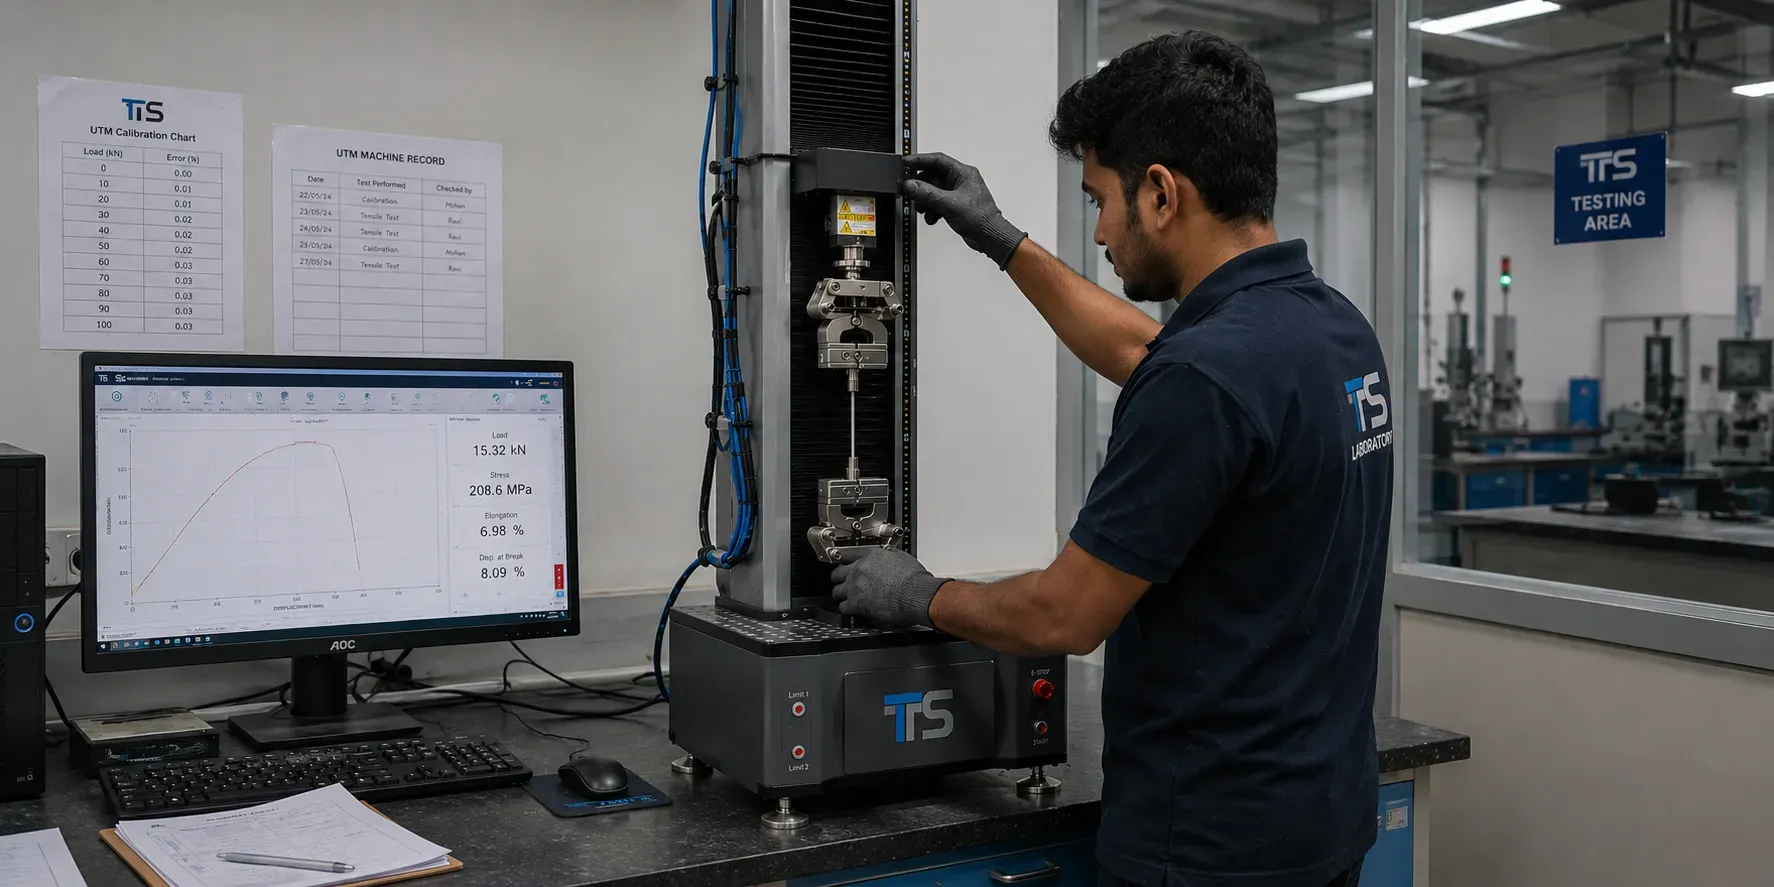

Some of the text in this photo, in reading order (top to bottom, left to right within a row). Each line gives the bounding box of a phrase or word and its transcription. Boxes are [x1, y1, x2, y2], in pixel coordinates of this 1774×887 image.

[90, 126, 196, 142] UTM Calibration Chart
[84, 148, 123, 158] Load (kN)
[167, 154, 186, 162] Error
[336, 149, 445, 166] UTM MACHINE RECORD
[101, 164, 106, 172] 0
[174, 170, 193, 178] 0.00
[99, 180, 109, 188] 10
[373, 180, 406, 189] Performed
[436, 185, 472, 195] Checked by
[98, 196, 109, 204] 20
[362, 196, 398, 204] Calibration
[1571, 190, 1646, 212] TESTING
[98, 211, 109, 219] 30
[360, 212, 382, 220] Tensile
[174, 216, 193, 224] 0.02
[1584, 212, 1632, 231] AREA
[174, 231, 193, 239] 0.02
[98, 242, 109, 250] 50
[174, 246, 193, 254] 0.02
[98, 258, 109, 266] 60
[174, 277, 193, 285] 0.03
[98, 305, 109, 313] 90
[97, 321, 112, 329] 100
[174, 323, 193, 331] 0.03
[473, 445, 526, 456] 15.32 kN
[470, 484, 532, 496] 208.6 MPa
[484, 511, 518, 520] Elongation
[480, 524, 524, 537] 6.98 %
[479, 554, 494, 562] Disp.
[506, 552, 523, 560] Break
[481, 566, 525, 579] 8.09 %
[330, 640, 355, 650] AOC
